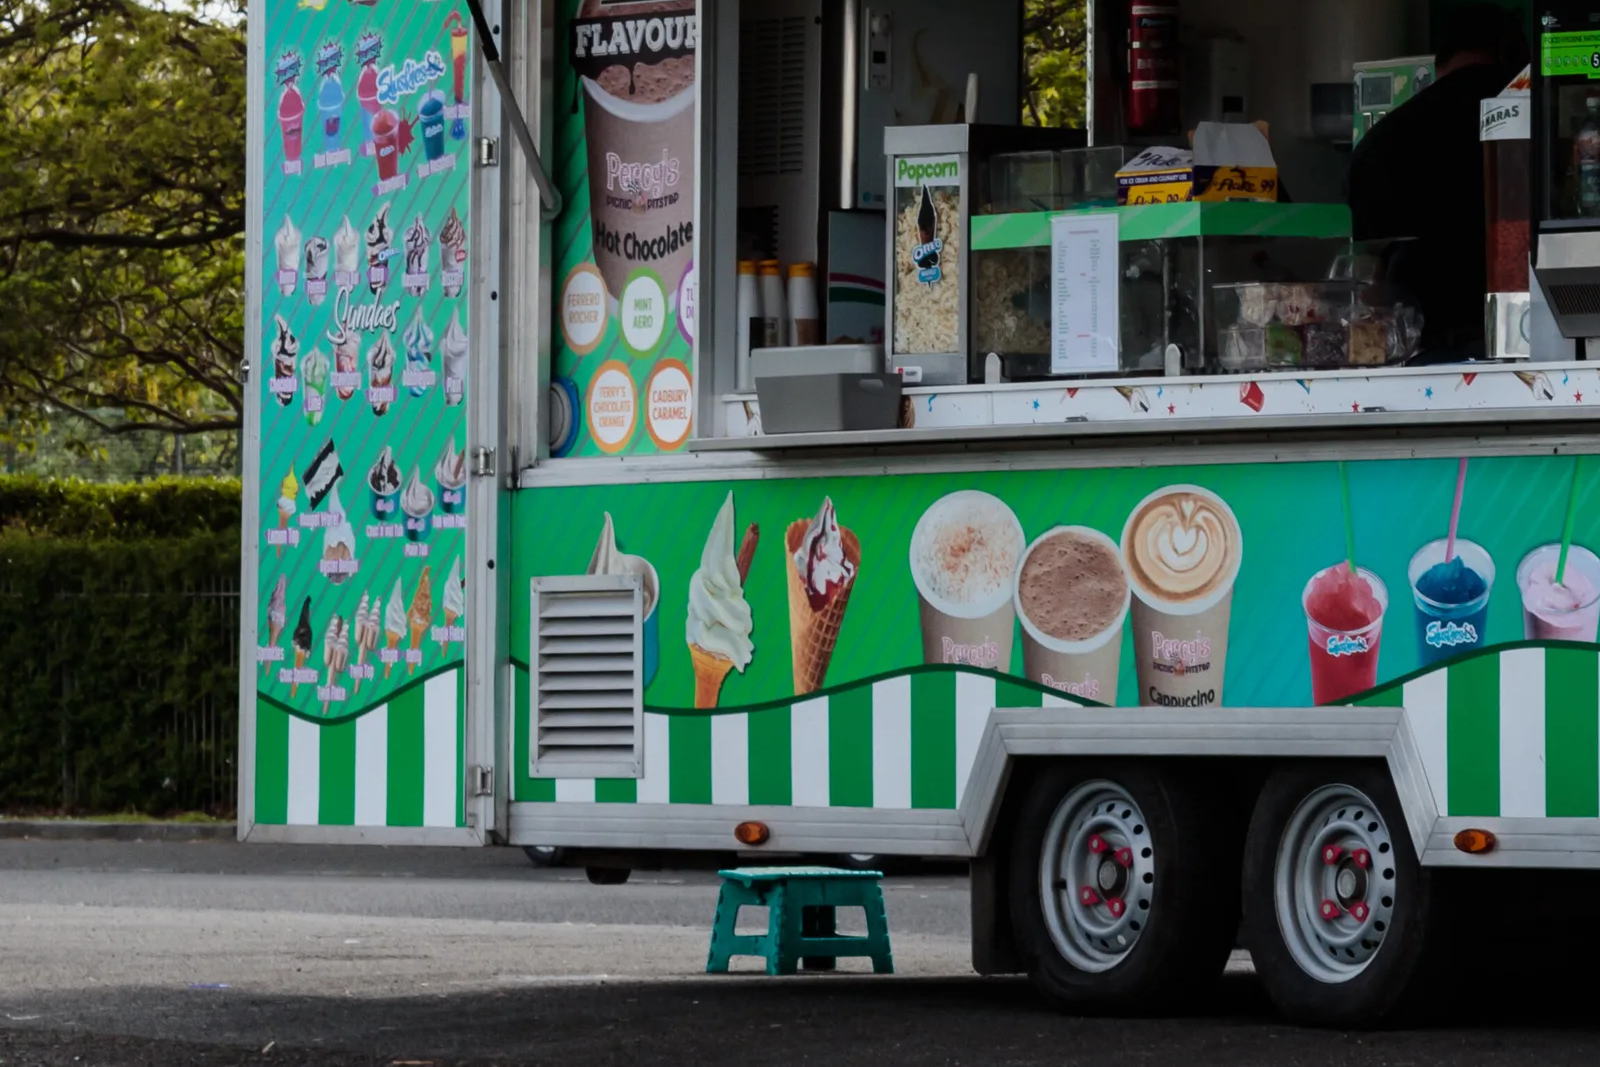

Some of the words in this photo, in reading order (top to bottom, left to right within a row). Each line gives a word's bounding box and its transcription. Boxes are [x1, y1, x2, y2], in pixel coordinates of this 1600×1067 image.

[1593, 54, 1600, 66] 5
[606, 149, 679, 197] Percy's
[898, 159, 958, 184] Popcorn
[1261, 180, 1275, 193] 99
[595, 220, 620, 259] Hot
[623, 220, 693, 262] Chocolate
[568, 292, 599, 309] FERRERO
[634, 297, 652, 312] MINT
[327, 286, 400, 345] Sundaes
[569, 307, 598, 324] ROCHER
[633, 313, 653, 330] AERO
[599, 386, 626, 398] TERRY'S
[652, 389, 688, 404] CADBURY
[594, 399, 631, 415] CHOCOLATE
[653, 404, 688, 420] CARAMEL
[599, 414, 625, 428] ORANGE
[1152, 631, 1211, 664] Percy's
